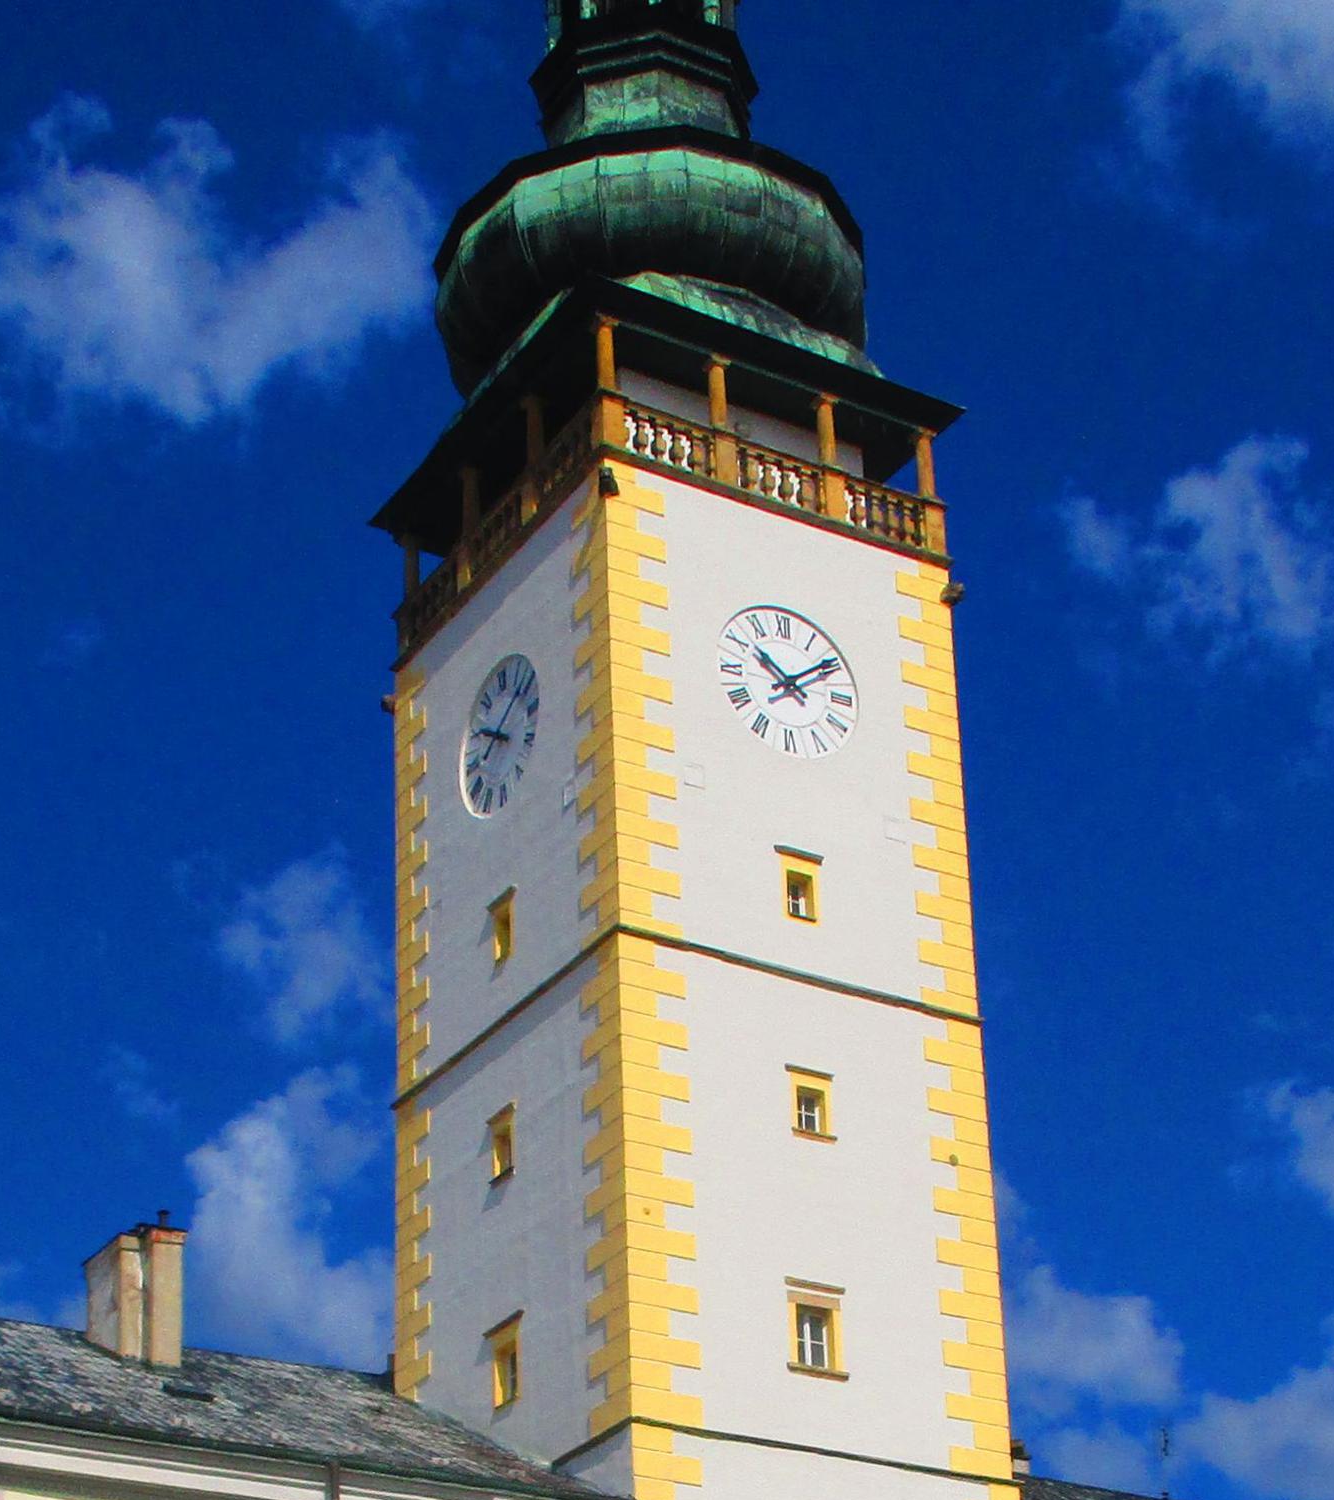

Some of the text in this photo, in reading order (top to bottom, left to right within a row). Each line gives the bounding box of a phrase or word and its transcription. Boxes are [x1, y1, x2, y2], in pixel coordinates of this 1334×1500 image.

[745, 614, 766, 639] XI
[775, 613, 791, 639] XII
[725, 629, 749, 652] X
[805, 632, 816, 651] I
[720, 657, 743, 676] IX
[727, 687, 752, 711] VIII
[830, 691, 852, 707] III
[751, 712, 769, 739] VII
[784, 729, 797, 753] VI
[810, 729, 827, 753] V
